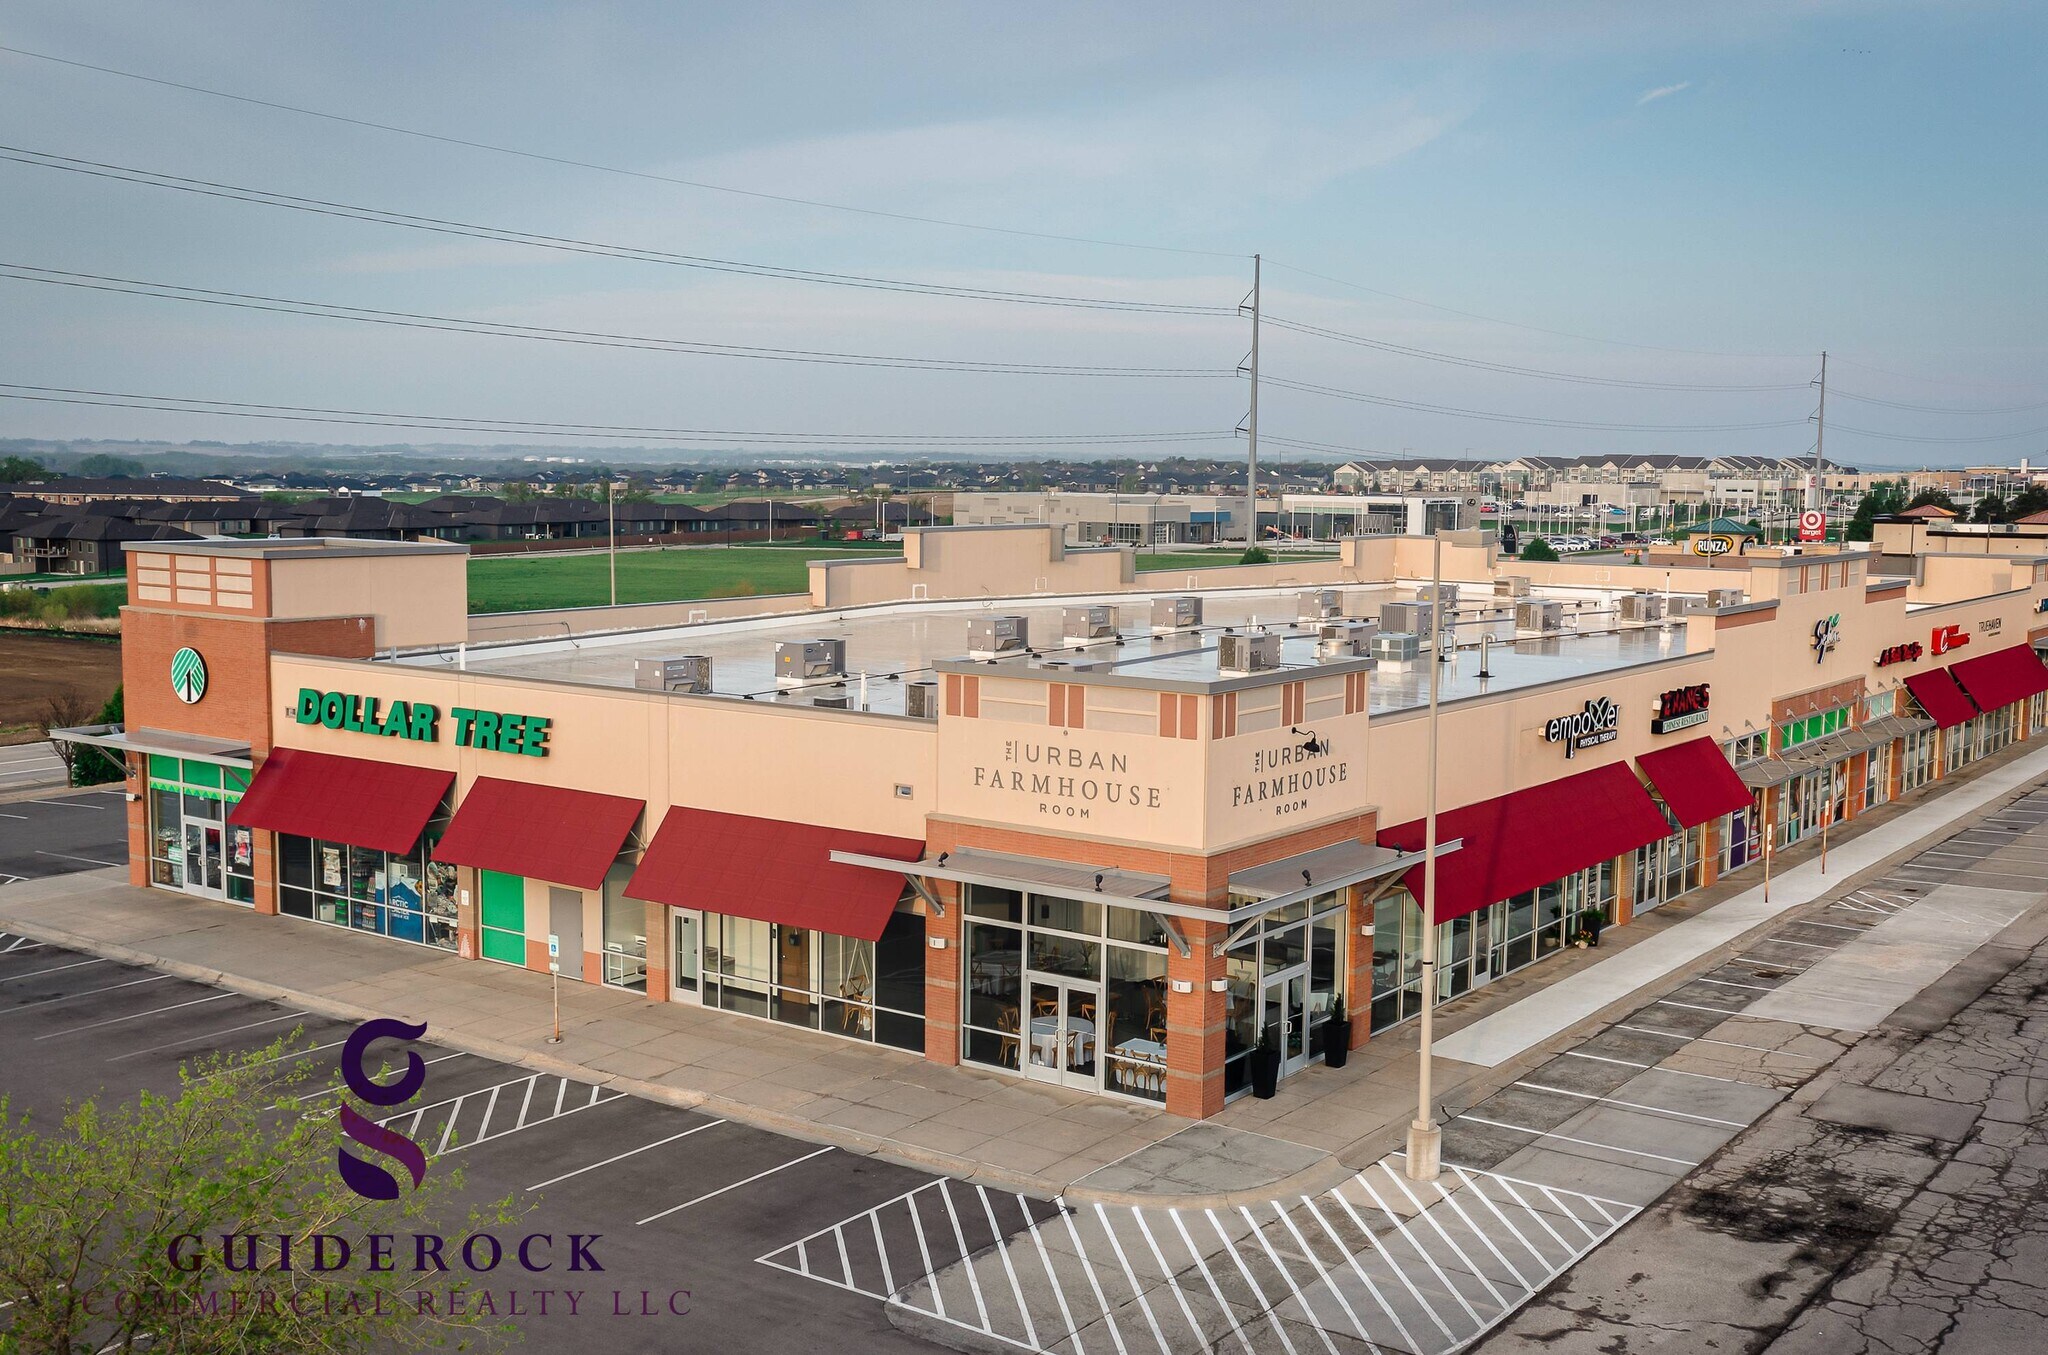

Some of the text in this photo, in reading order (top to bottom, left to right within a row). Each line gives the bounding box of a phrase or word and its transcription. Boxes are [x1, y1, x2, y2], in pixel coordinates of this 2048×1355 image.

[1698, 540, 1729, 553] RUNZA
[296, 688, 551, 757] DOLLAR TREE
[1580, 730, 1617, 748] PHYSICAL THERAPY
[1026, 744, 1127, 773] URBAN
[974, 766, 1161, 808] FARMHOUSE
[1233, 762, 1347, 807] FARMHOUSE
[1040, 803, 1089, 818] ROOM
[1276, 799, 1308, 815] ROOM
